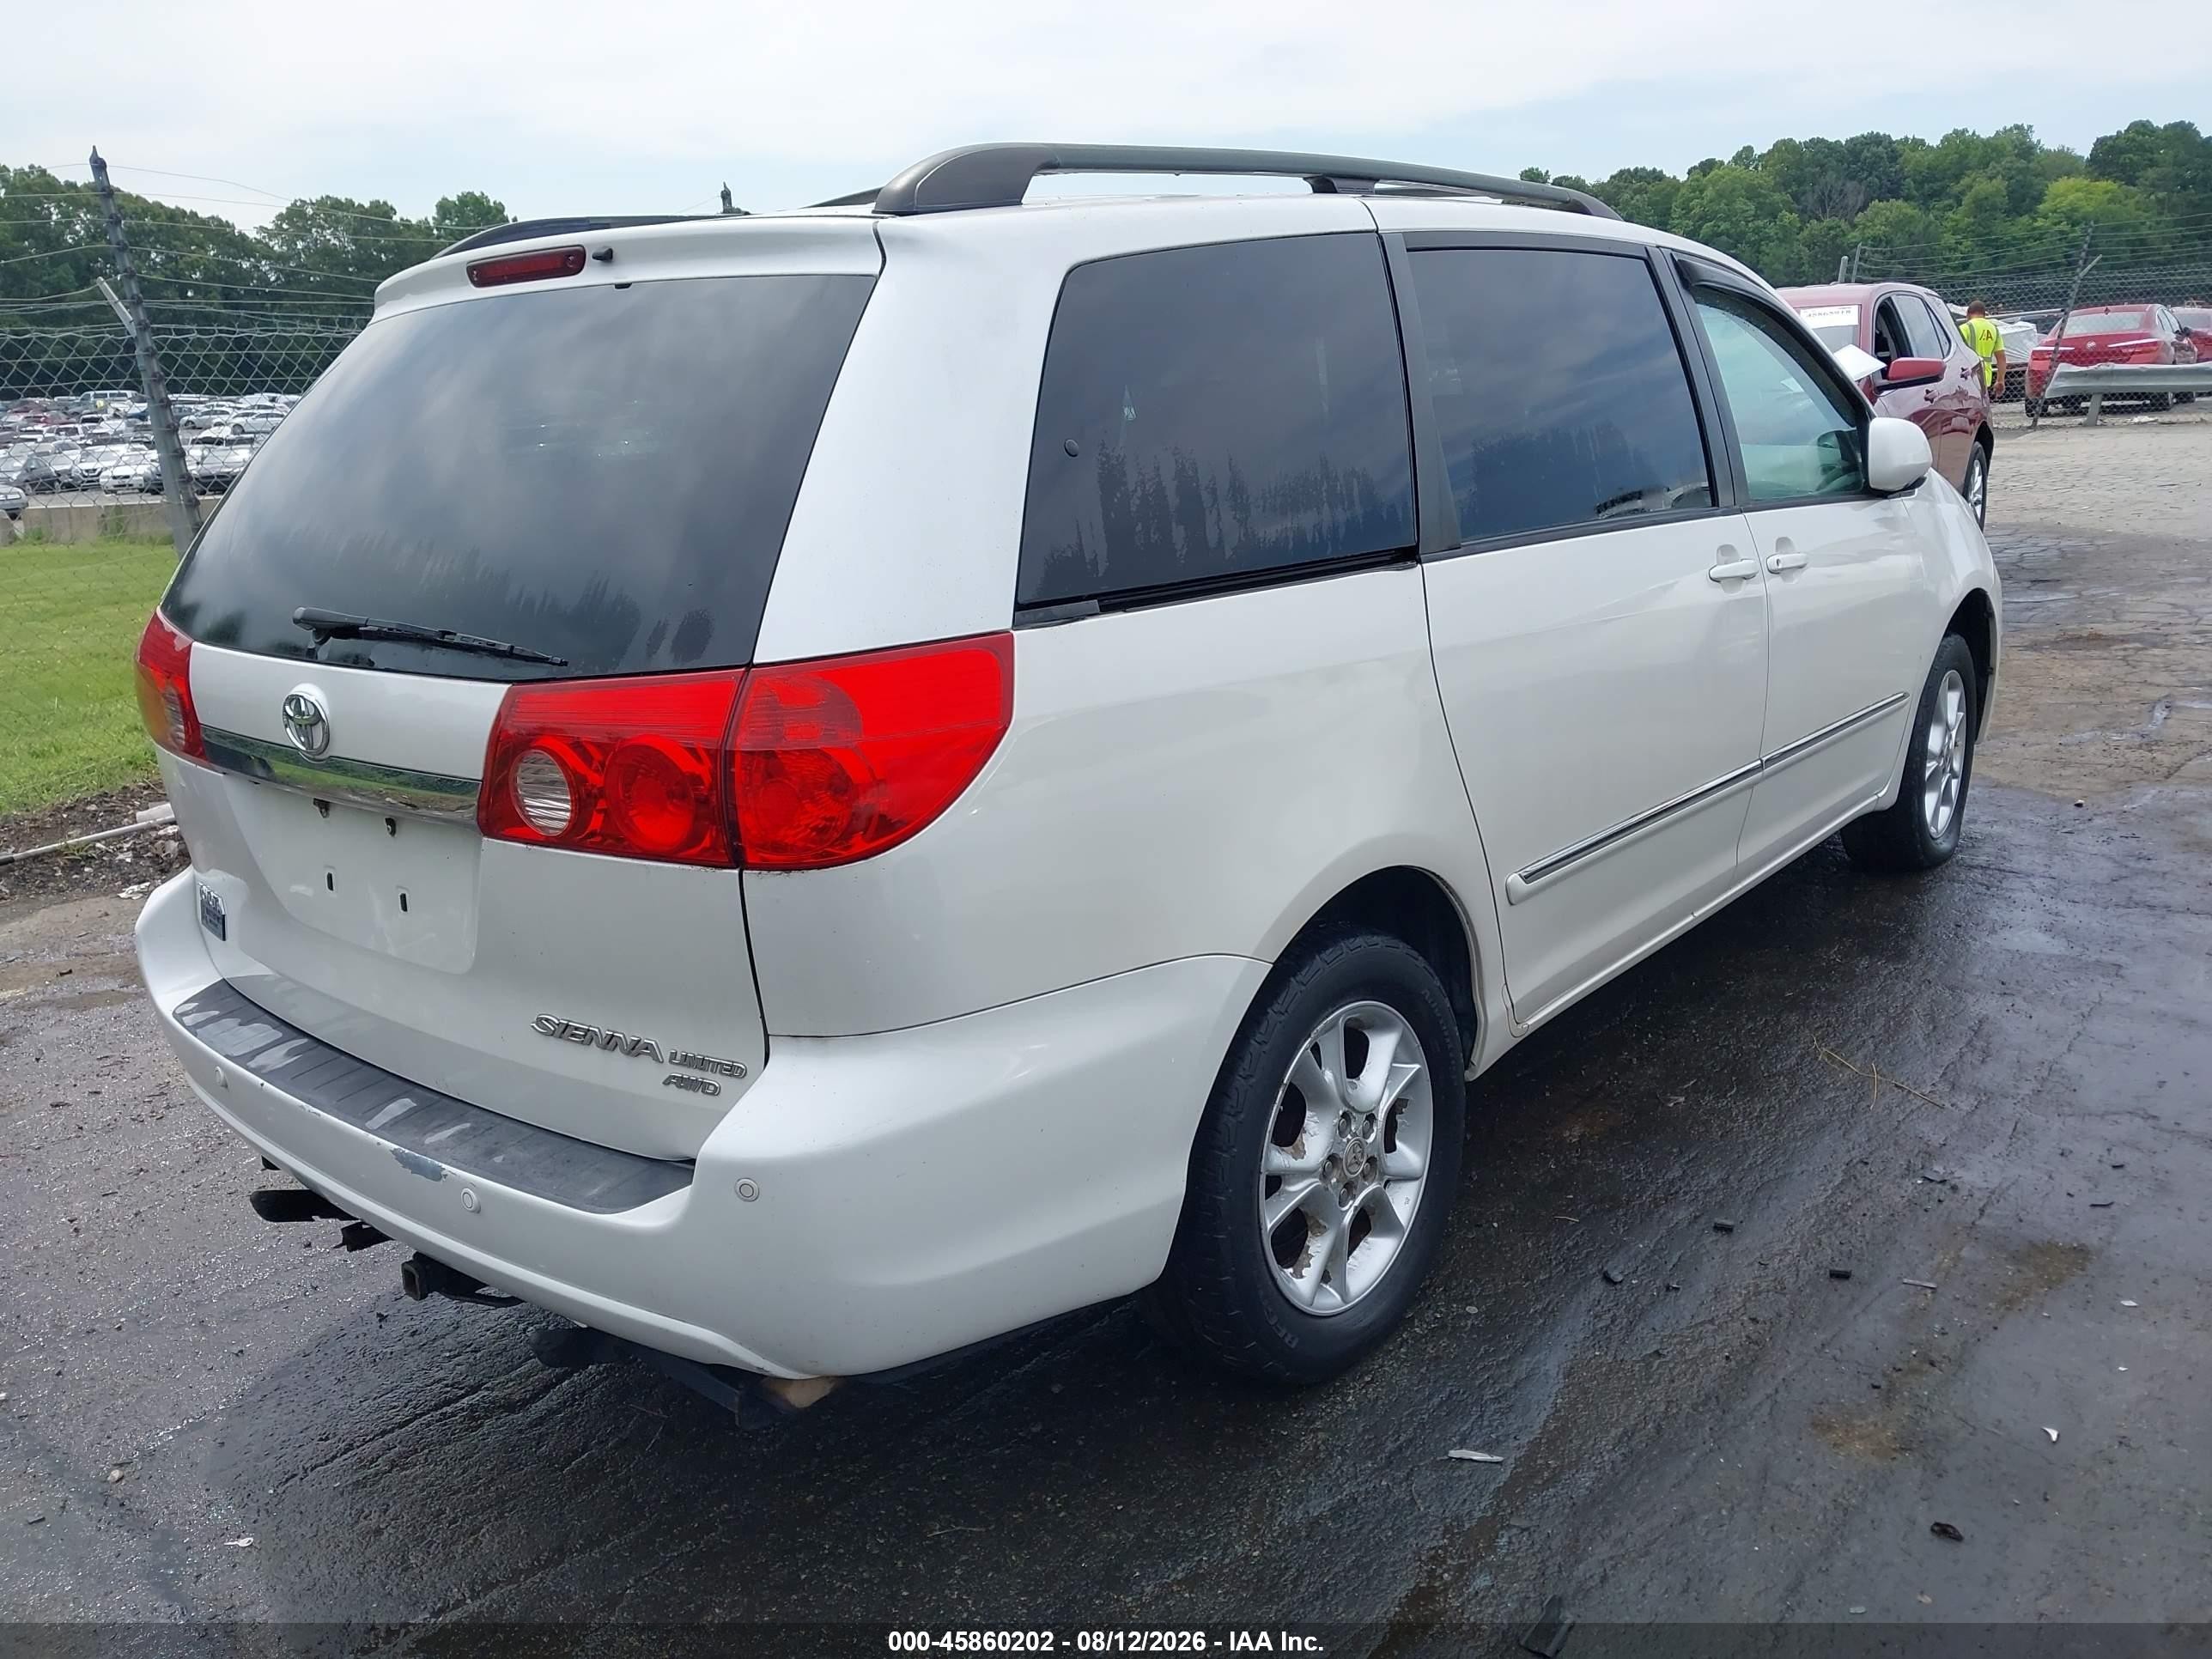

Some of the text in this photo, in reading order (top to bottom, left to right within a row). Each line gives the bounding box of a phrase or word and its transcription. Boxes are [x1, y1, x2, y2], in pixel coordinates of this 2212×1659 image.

[531, 1013, 748, 1079] SIENNA LIMITED
[662, 1073, 721, 1097] AWD
